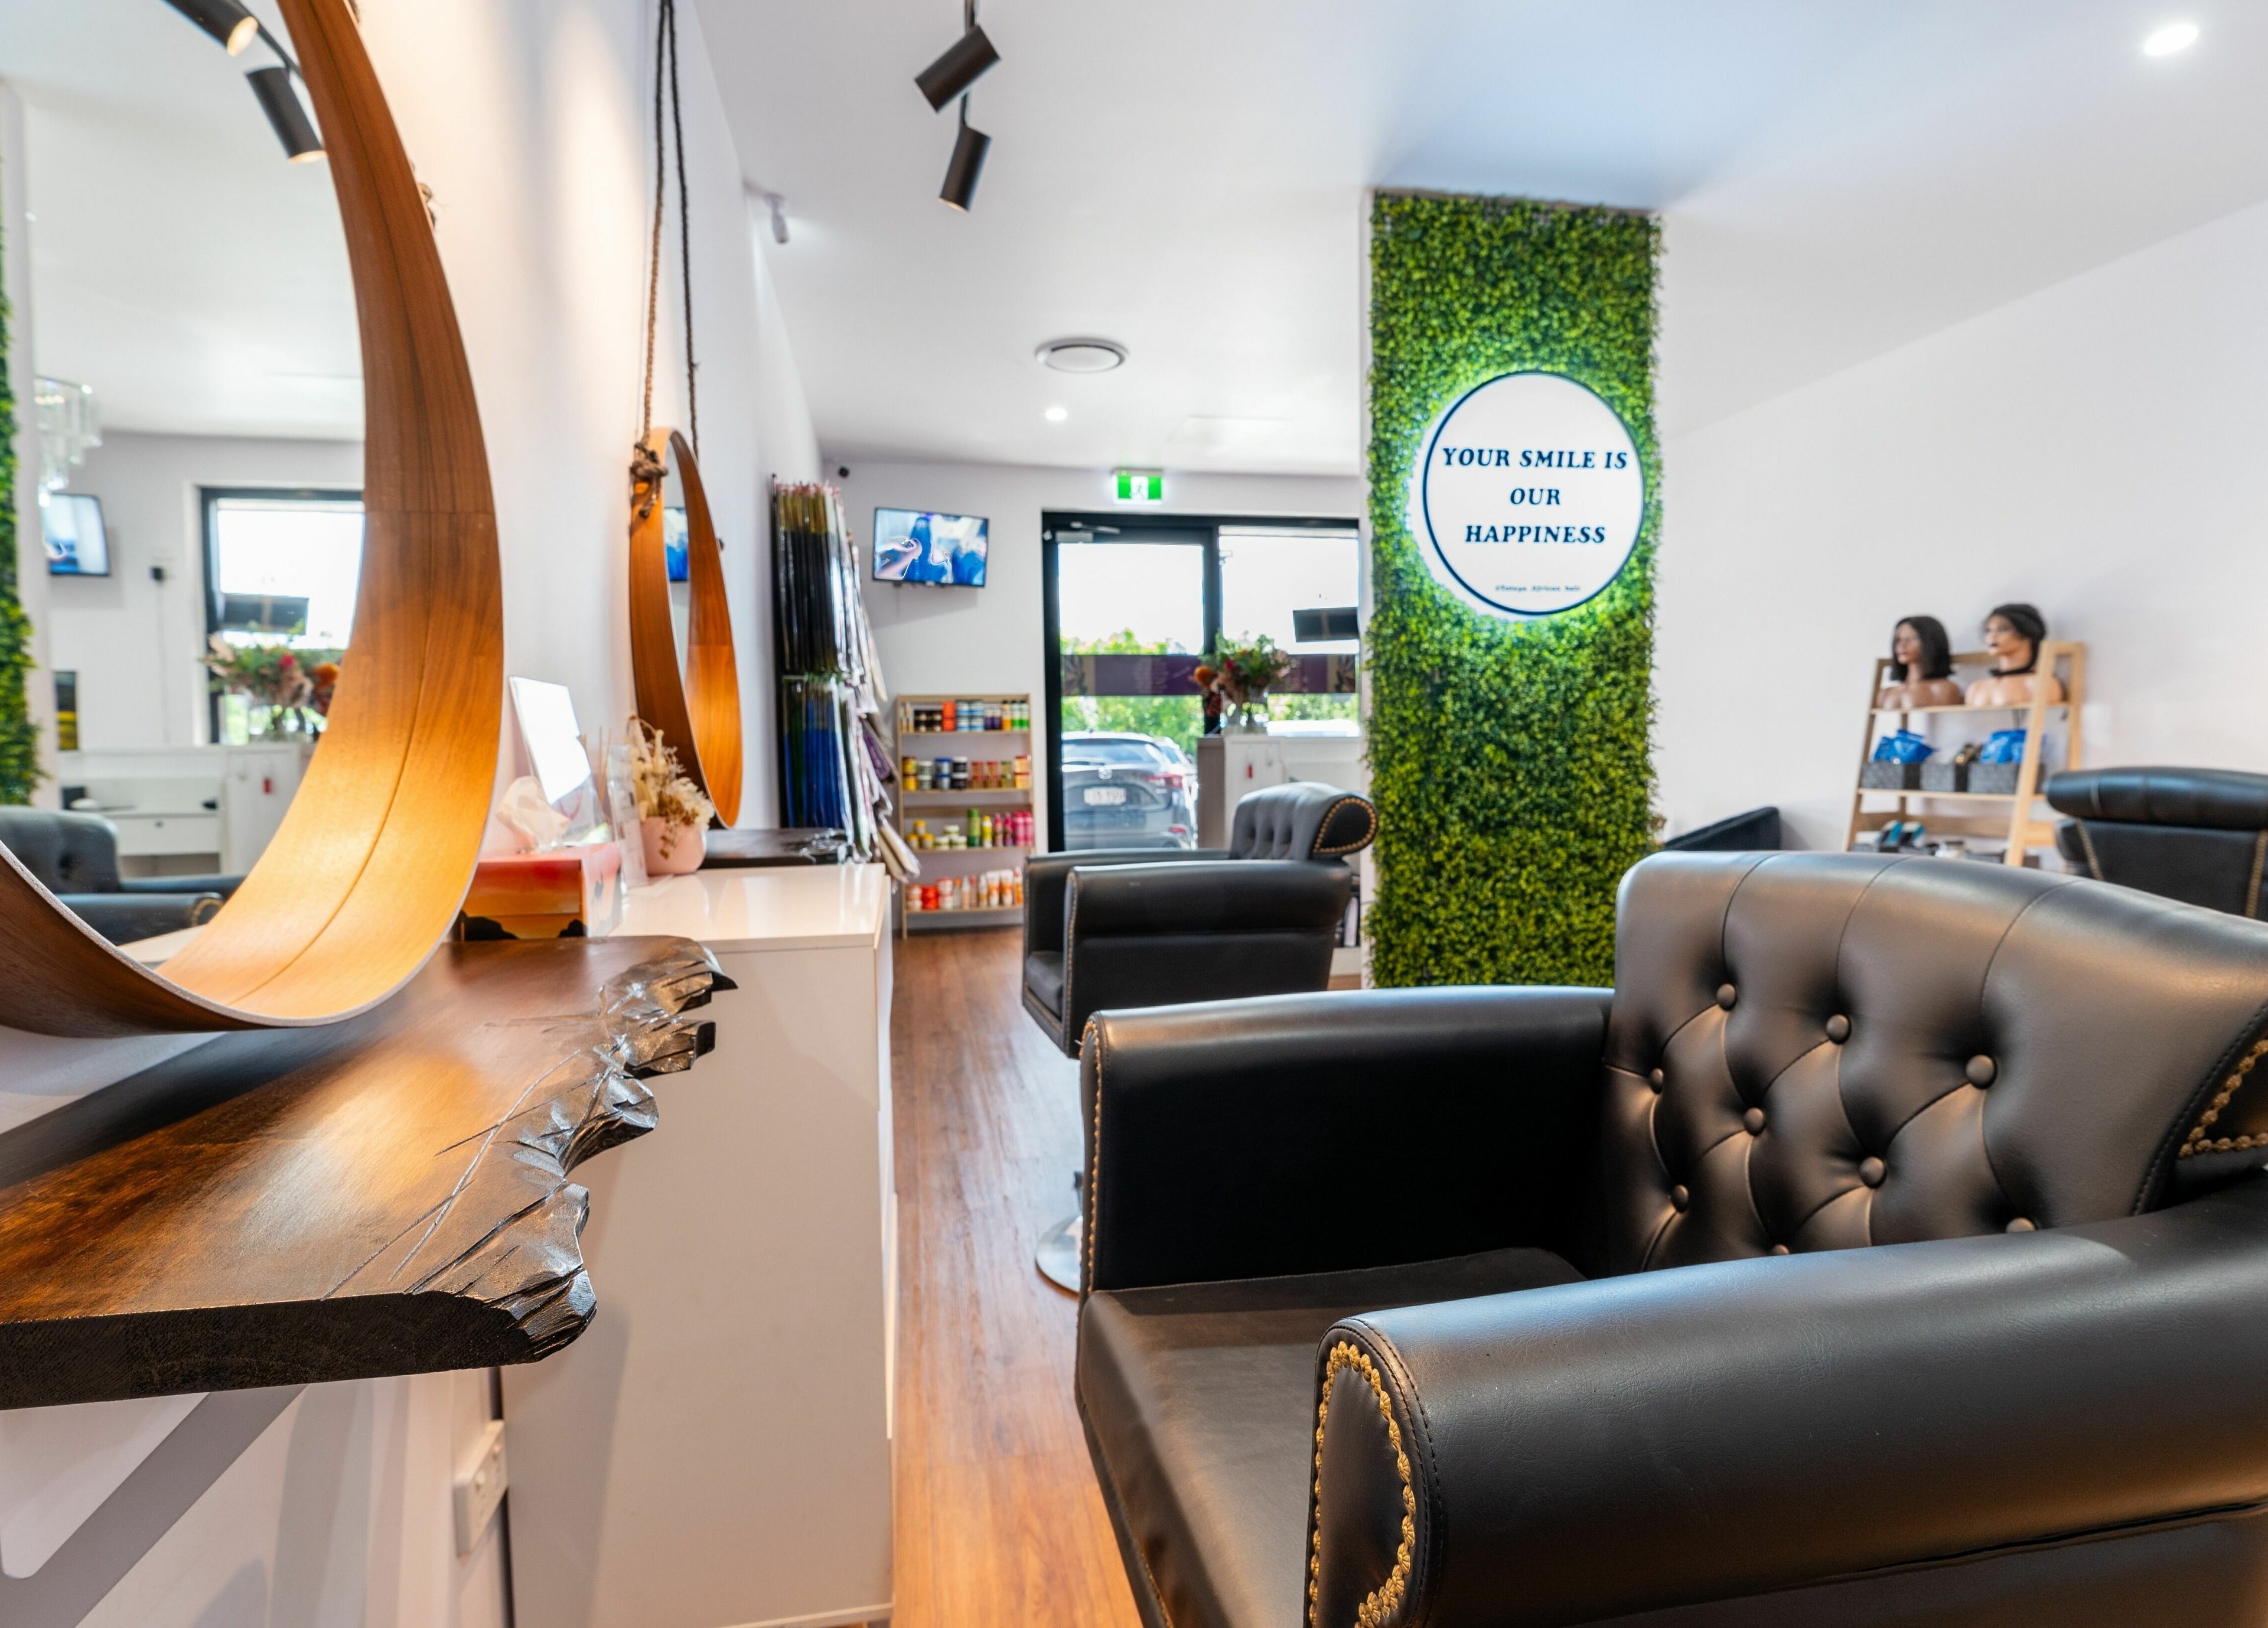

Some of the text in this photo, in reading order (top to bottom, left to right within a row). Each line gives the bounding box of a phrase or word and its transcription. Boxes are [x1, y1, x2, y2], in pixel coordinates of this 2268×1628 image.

[1443, 448, 1627, 469] YOUR SMILE IS
[1510, 488, 1560, 505] OUR
[1465, 525, 1605, 543] HAPPINESS
